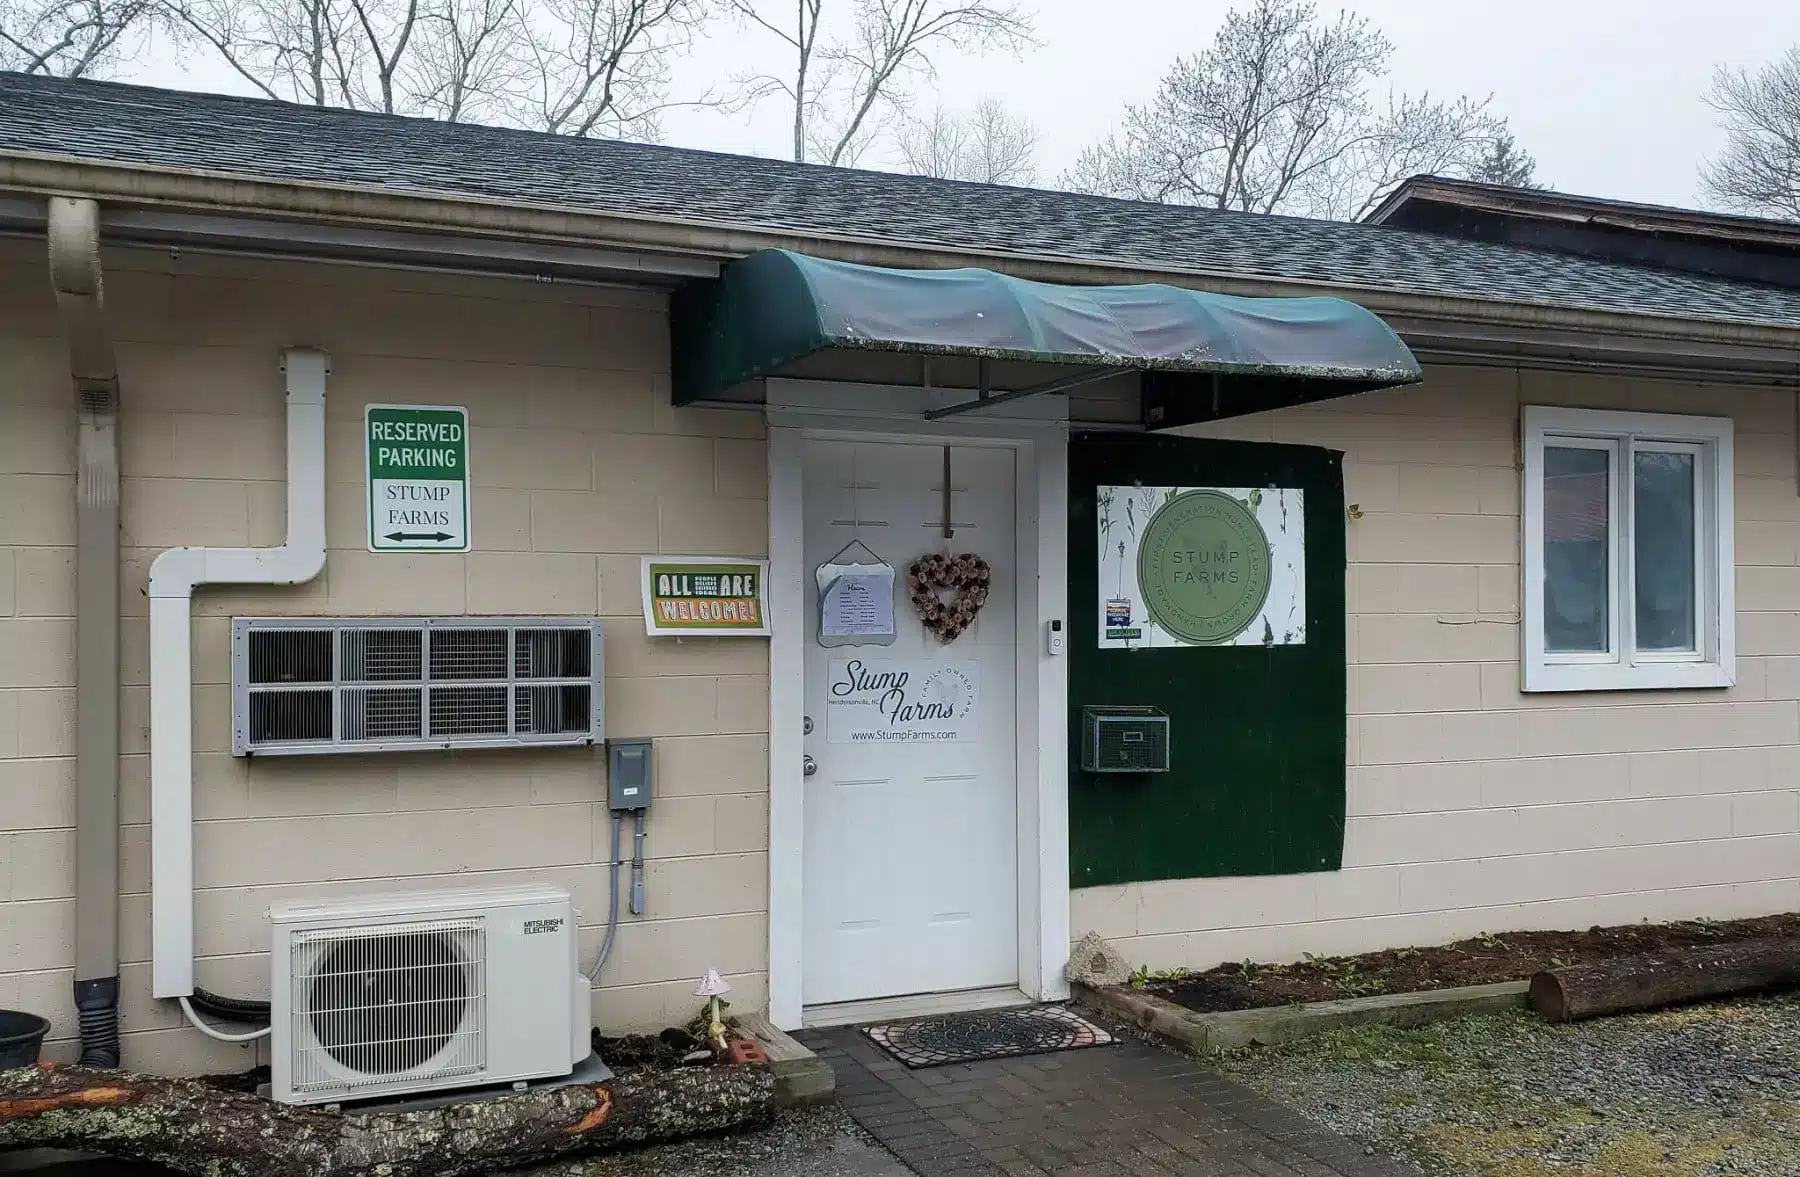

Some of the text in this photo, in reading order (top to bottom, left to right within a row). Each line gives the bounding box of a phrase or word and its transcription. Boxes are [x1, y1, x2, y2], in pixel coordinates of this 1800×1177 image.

[372, 421, 461, 441] RESERVED
[379, 447, 456, 467] PARKING
[387, 485, 450, 501] STUMP
[389, 509, 449, 525] FARMS
[1172, 551, 1240, 564] STUMP
[659, 574, 692, 596] ALL
[720, 574, 753, 596] ARE
[1173, 571, 1240, 584] FARMS
[660, 601, 755, 620] WELCOME!
[832, 660, 909, 699] Stump
[880, 688, 954, 726] Farms
[851, 730, 957, 740] www.StumpFarms.com
[524, 918, 564, 927] MITSUBISHI
[524, 925, 559, 935] ELECTRIC
